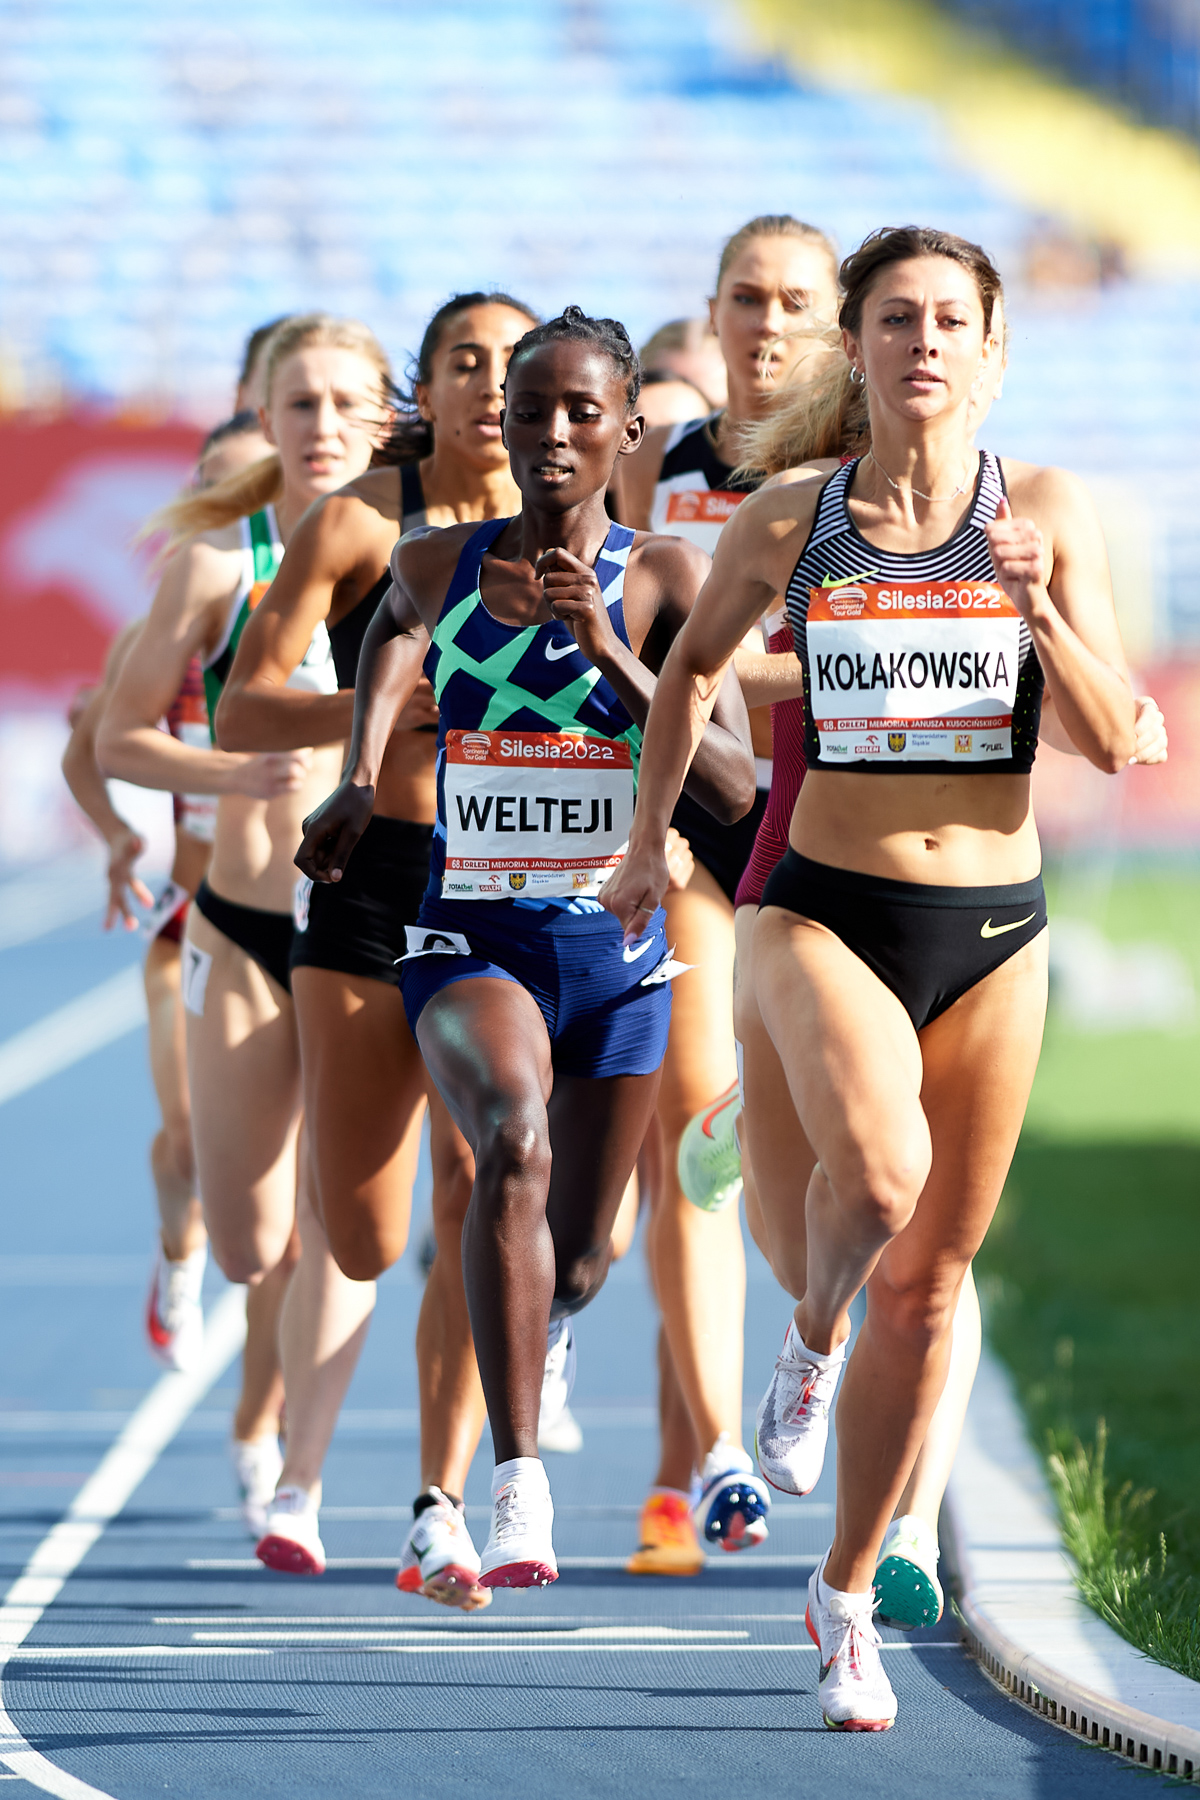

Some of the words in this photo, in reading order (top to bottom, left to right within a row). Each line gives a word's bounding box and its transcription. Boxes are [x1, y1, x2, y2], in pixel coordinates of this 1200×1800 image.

[877, 588, 1001, 609] Silesia2022
[847, 608, 861, 616] Gold
[816, 652, 1009, 691] KOŁAKOWSKA
[823, 721, 837, 730] 68.
[839, 721, 866, 729] ORLEN
[911, 720, 945, 728] JANUSZA
[946, 719, 1003, 728] KUSOCIŃSKIEGO
[500, 739, 615, 759] Silesia2022
[456, 795, 613, 833] WELTEJI
[452, 860, 463, 869] 68.
[563, 857, 621, 868] KUSOCIŃSKIEGO
